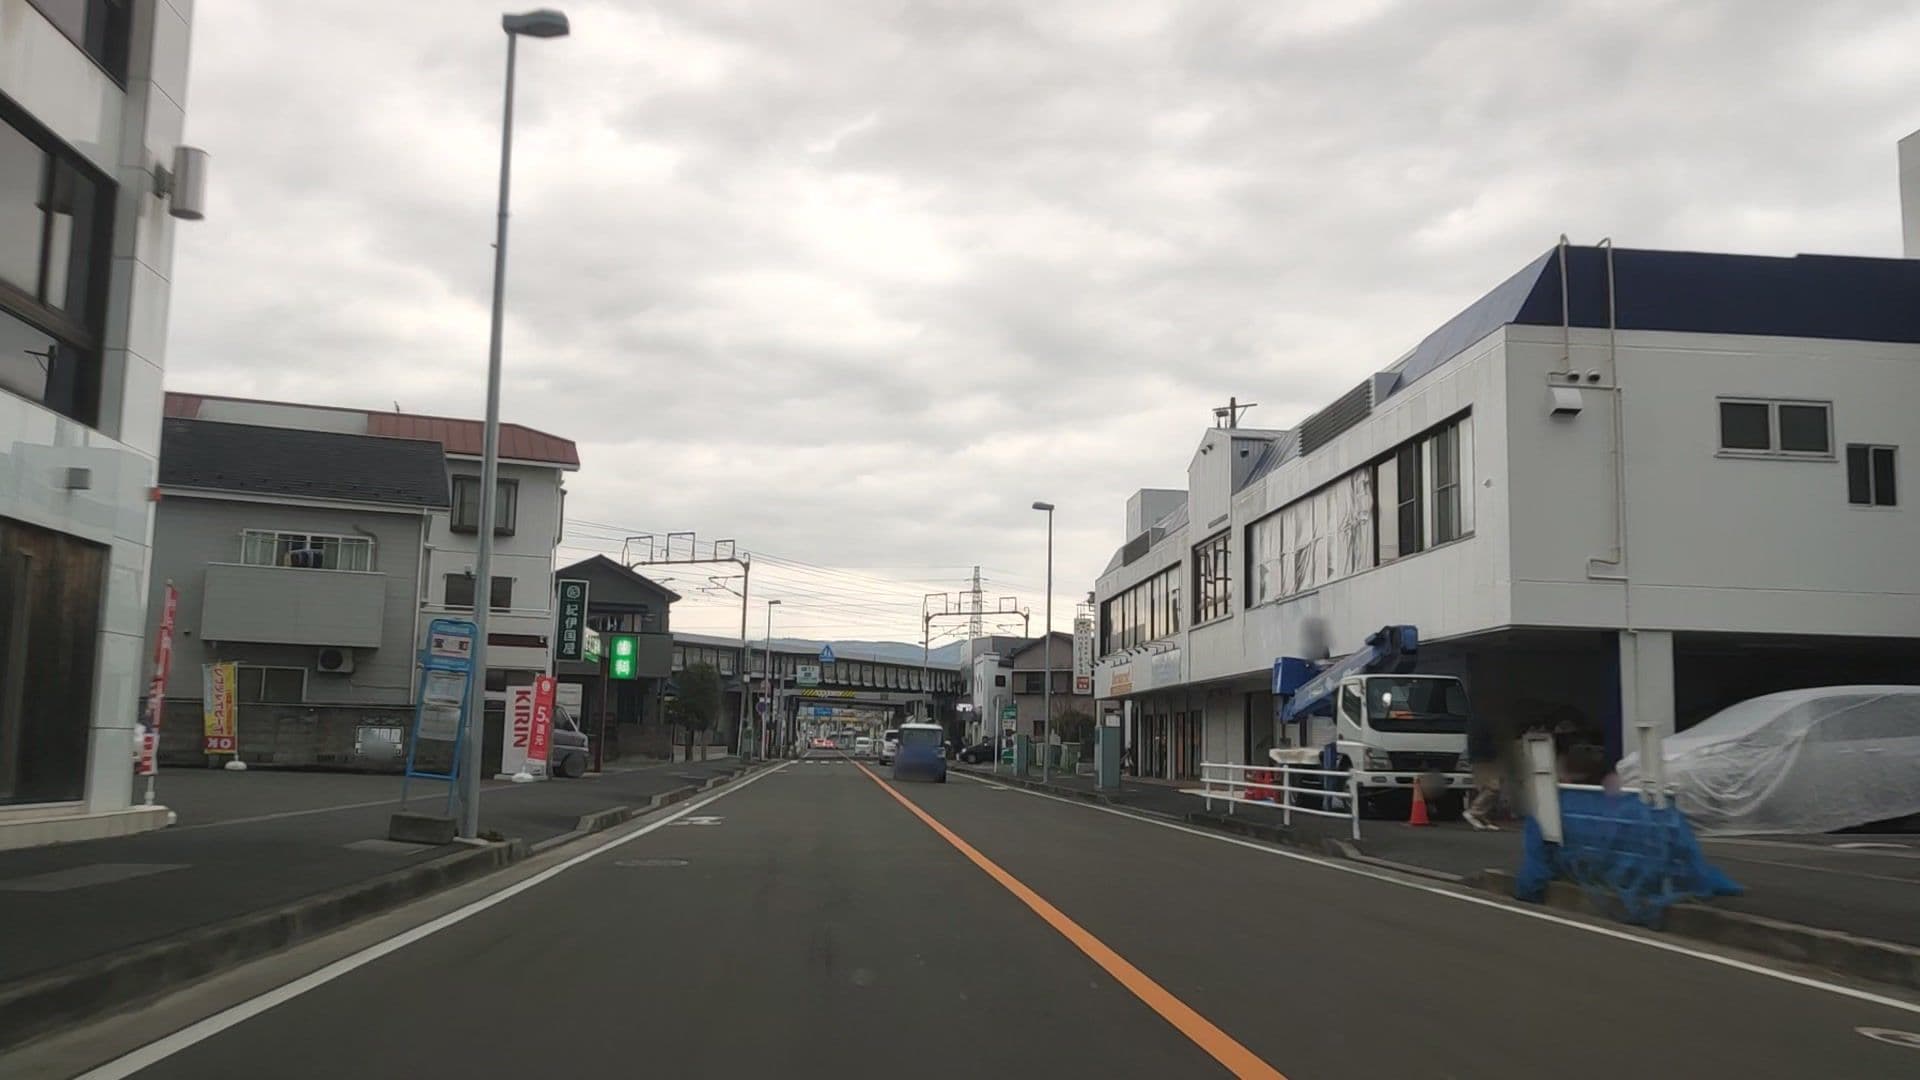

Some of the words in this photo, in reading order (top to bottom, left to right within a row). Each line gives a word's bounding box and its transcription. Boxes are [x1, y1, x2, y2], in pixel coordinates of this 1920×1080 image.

[563, 604, 579, 655] 紀伊国屋
[615, 640, 632, 676] 歯科
[513, 690, 532, 748] KIRIN
